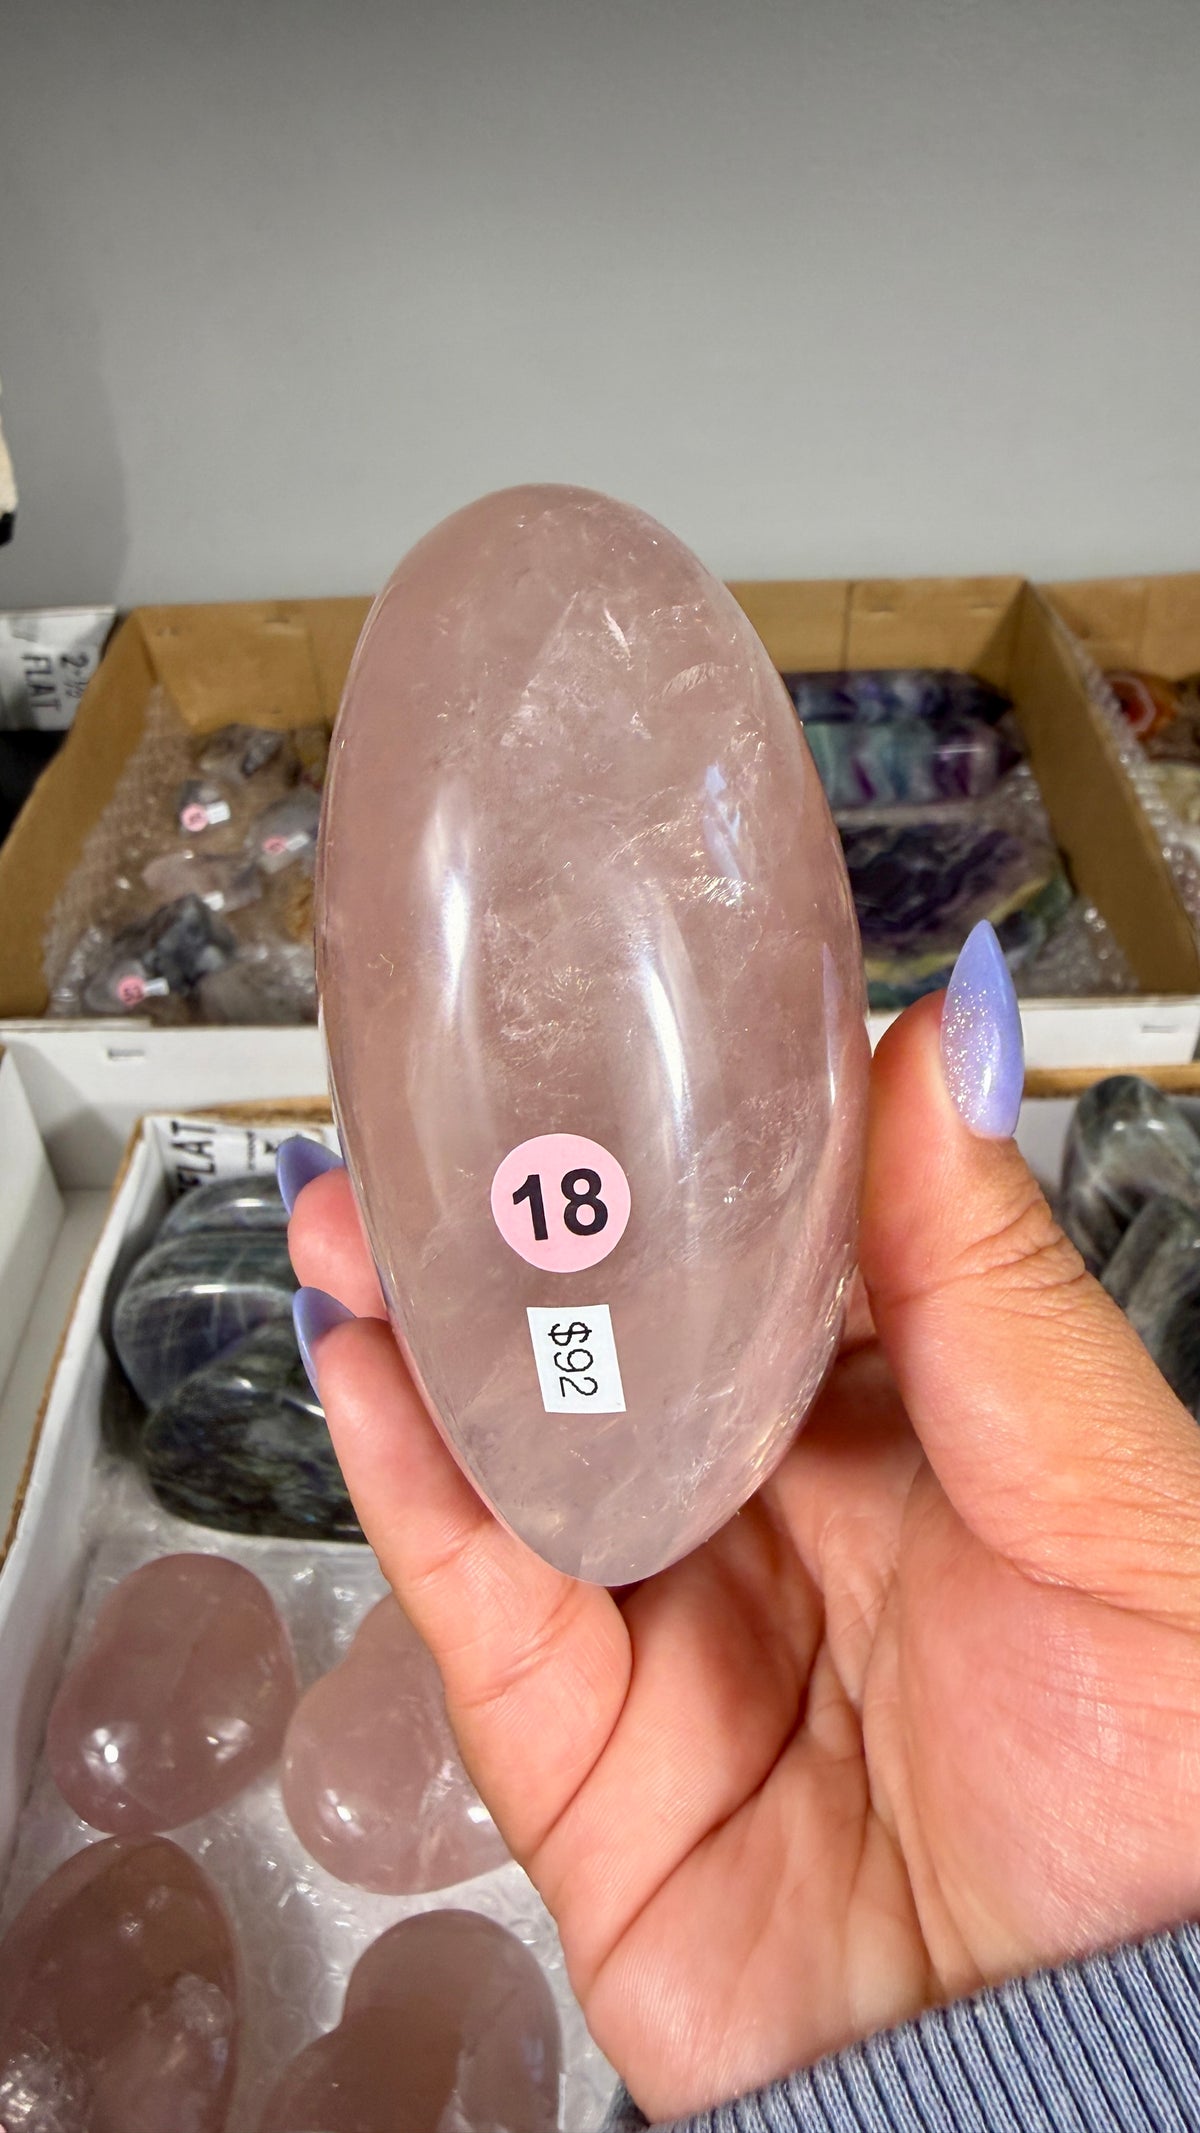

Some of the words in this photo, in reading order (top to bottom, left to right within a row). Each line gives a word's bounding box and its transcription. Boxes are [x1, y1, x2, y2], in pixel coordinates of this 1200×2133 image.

[22, 654, 61, 713] FLAT
[512, 1168, 609, 1241] 18
[548, 1321, 598, 1397] $92
